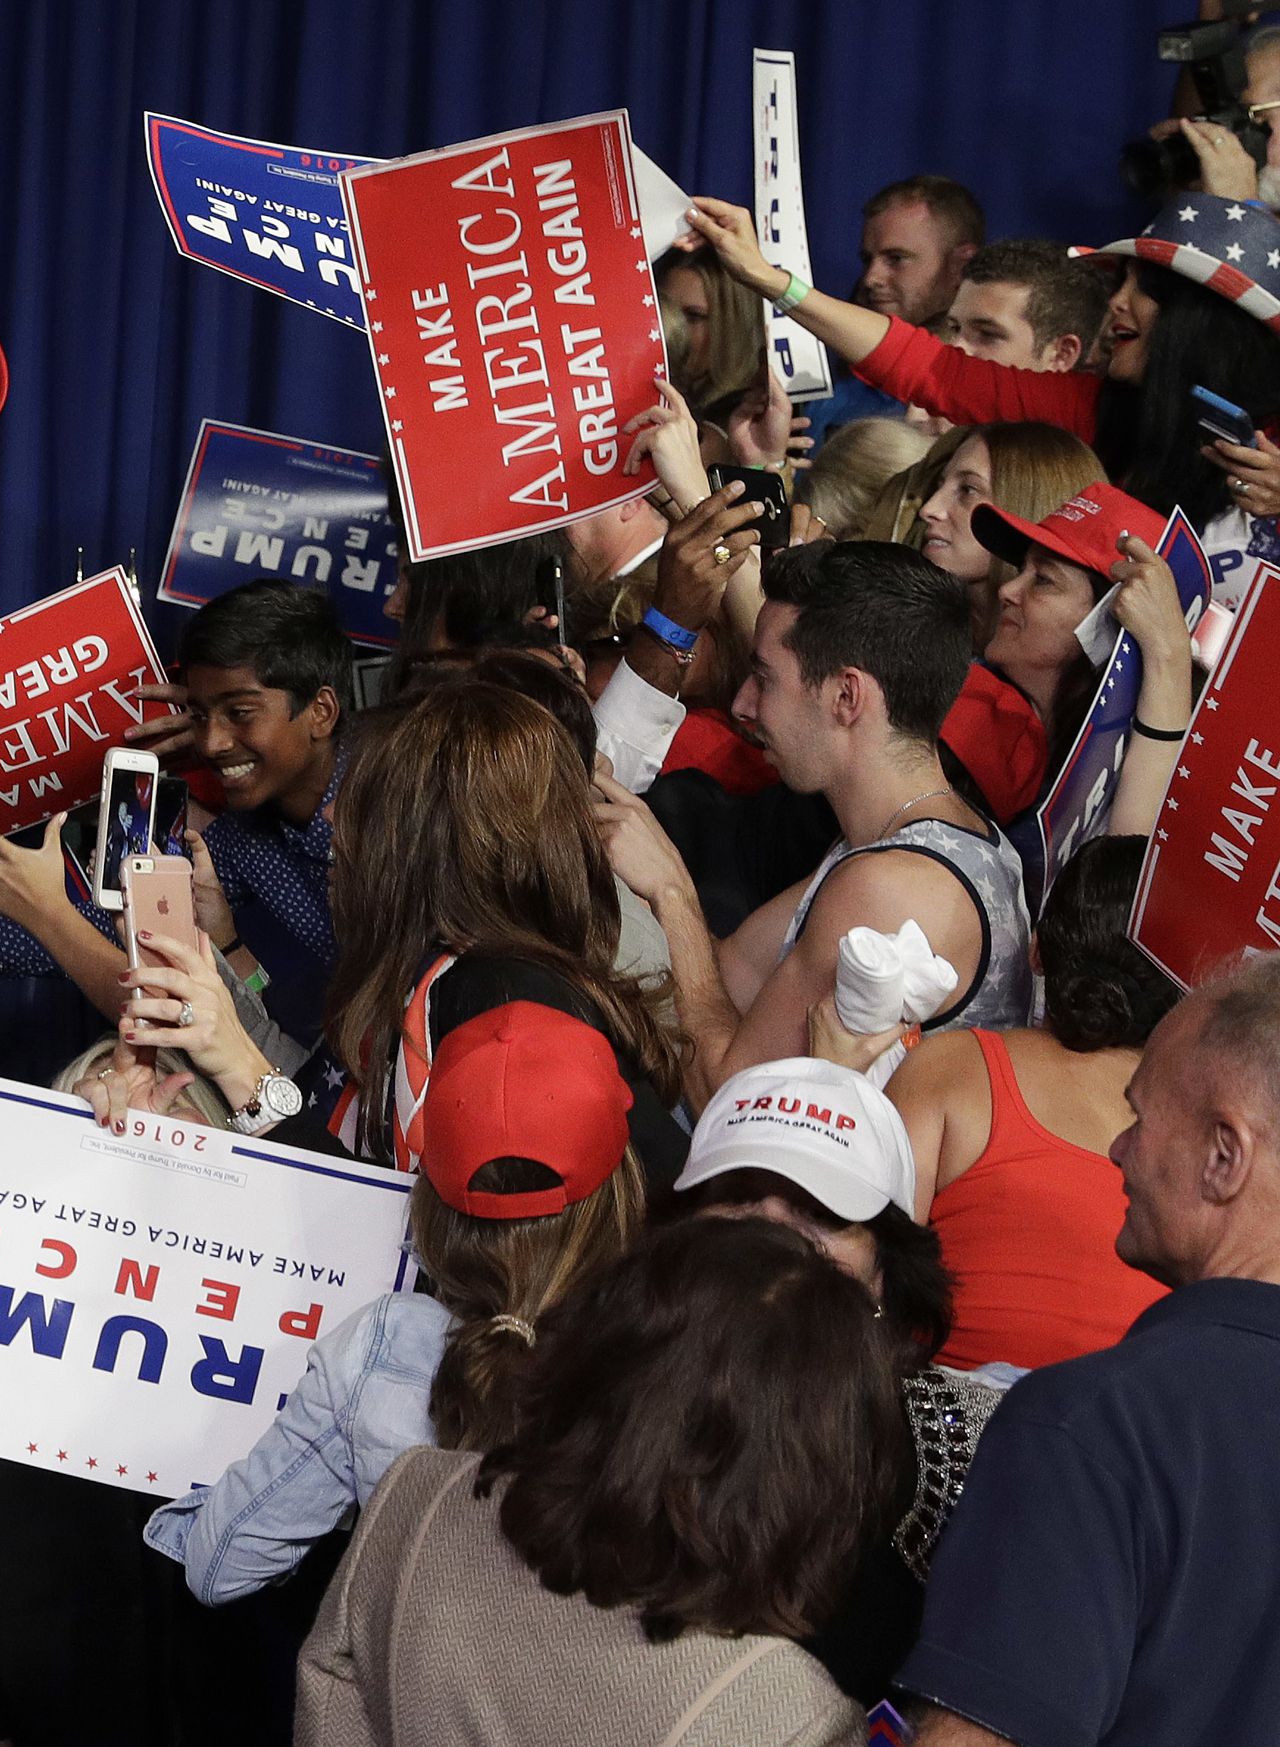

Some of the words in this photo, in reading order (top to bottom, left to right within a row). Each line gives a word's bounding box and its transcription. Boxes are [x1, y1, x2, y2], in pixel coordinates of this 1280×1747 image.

[195, 177, 258, 205] AGAIN!
[263, 200, 321, 224] GREAT
[207, 196, 346, 259] NCE
[532, 158, 595, 306] AGAIN
[770, 79, 794, 378] TRUP
[186, 214, 363, 295] UMP
[411, 281, 470, 413] MAKE
[451, 146, 569, 512] AMERICA
[561, 324, 617, 476] GREAT
[223, 478, 271, 497] AGAIN!
[190, 525, 398, 596] RUMP
[133, 1121, 208, 1151] 2016
[735, 1096, 856, 1131] TRUMP
[55, 1206, 138, 1236] GREAT
[148, 1225, 263, 1267] AMERICA
[273, 1257, 346, 1287] MAKE
